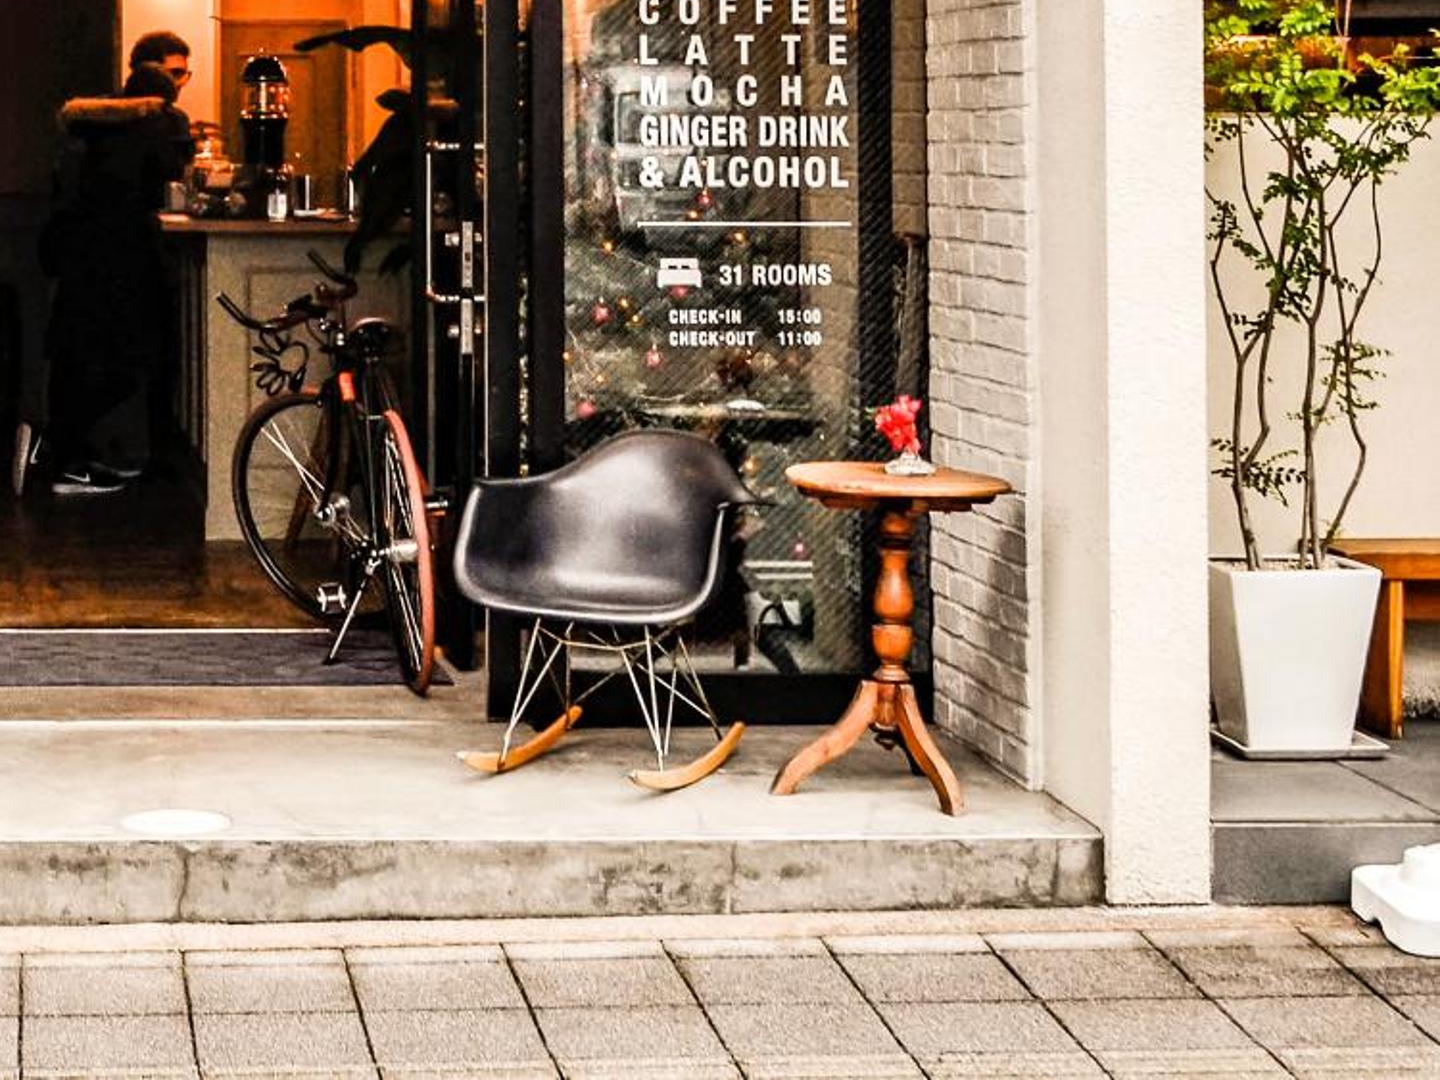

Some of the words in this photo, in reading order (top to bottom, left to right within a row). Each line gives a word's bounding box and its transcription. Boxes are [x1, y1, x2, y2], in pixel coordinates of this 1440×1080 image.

[639, 34, 848, 65] LATTE
[639, 75, 848, 107] MOCHA
[639, 115, 747, 148] GINGER
[758, 115, 849, 148] DRINK
[639, 156, 664, 188] &
[679, 156, 849, 188] ALCOHOL
[719, 264, 743, 286] 31
[752, 264, 832, 286] ROOMS
[668, 309, 742, 325] CHECK-IN
[777, 308, 822, 325] 15:00
[668, 330, 756, 347] CHECK-OUT
[777, 330, 822, 347] 11:00
